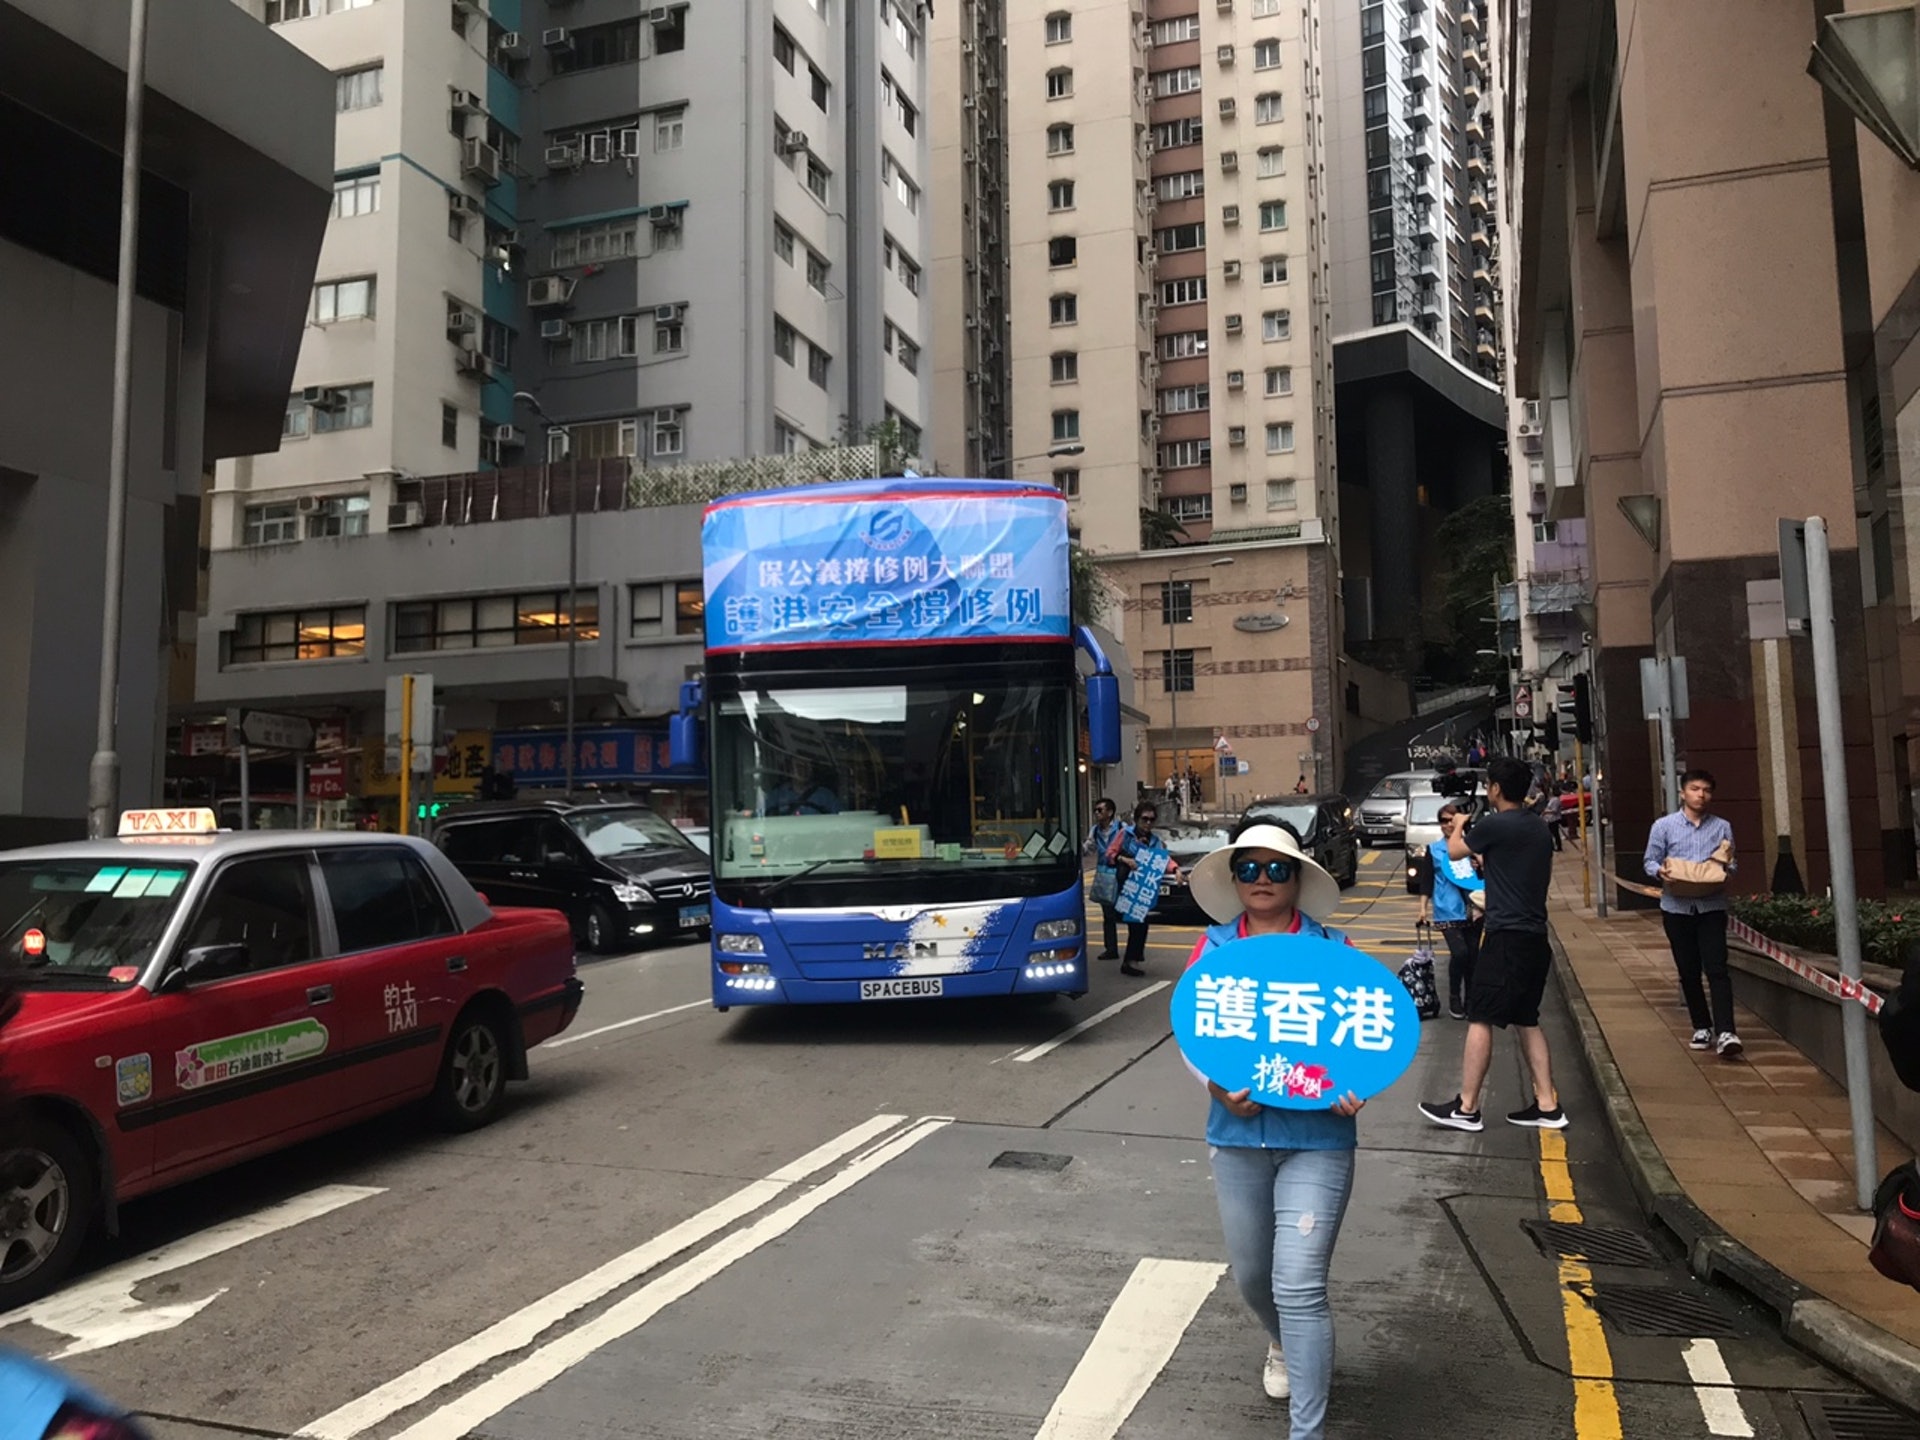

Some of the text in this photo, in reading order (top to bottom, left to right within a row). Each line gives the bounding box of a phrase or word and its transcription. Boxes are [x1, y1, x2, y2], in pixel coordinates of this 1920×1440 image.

[324, 780, 341, 792] Co.
[127, 811, 197, 830] TAXI
[863, 942, 937, 959] MAN
[384, 980, 416, 1007] 的士
[863, 980, 940, 997] SPACEBUS
[385, 1003, 417, 1033] TAXI
[1195, 974, 1395, 1052] 護香港
